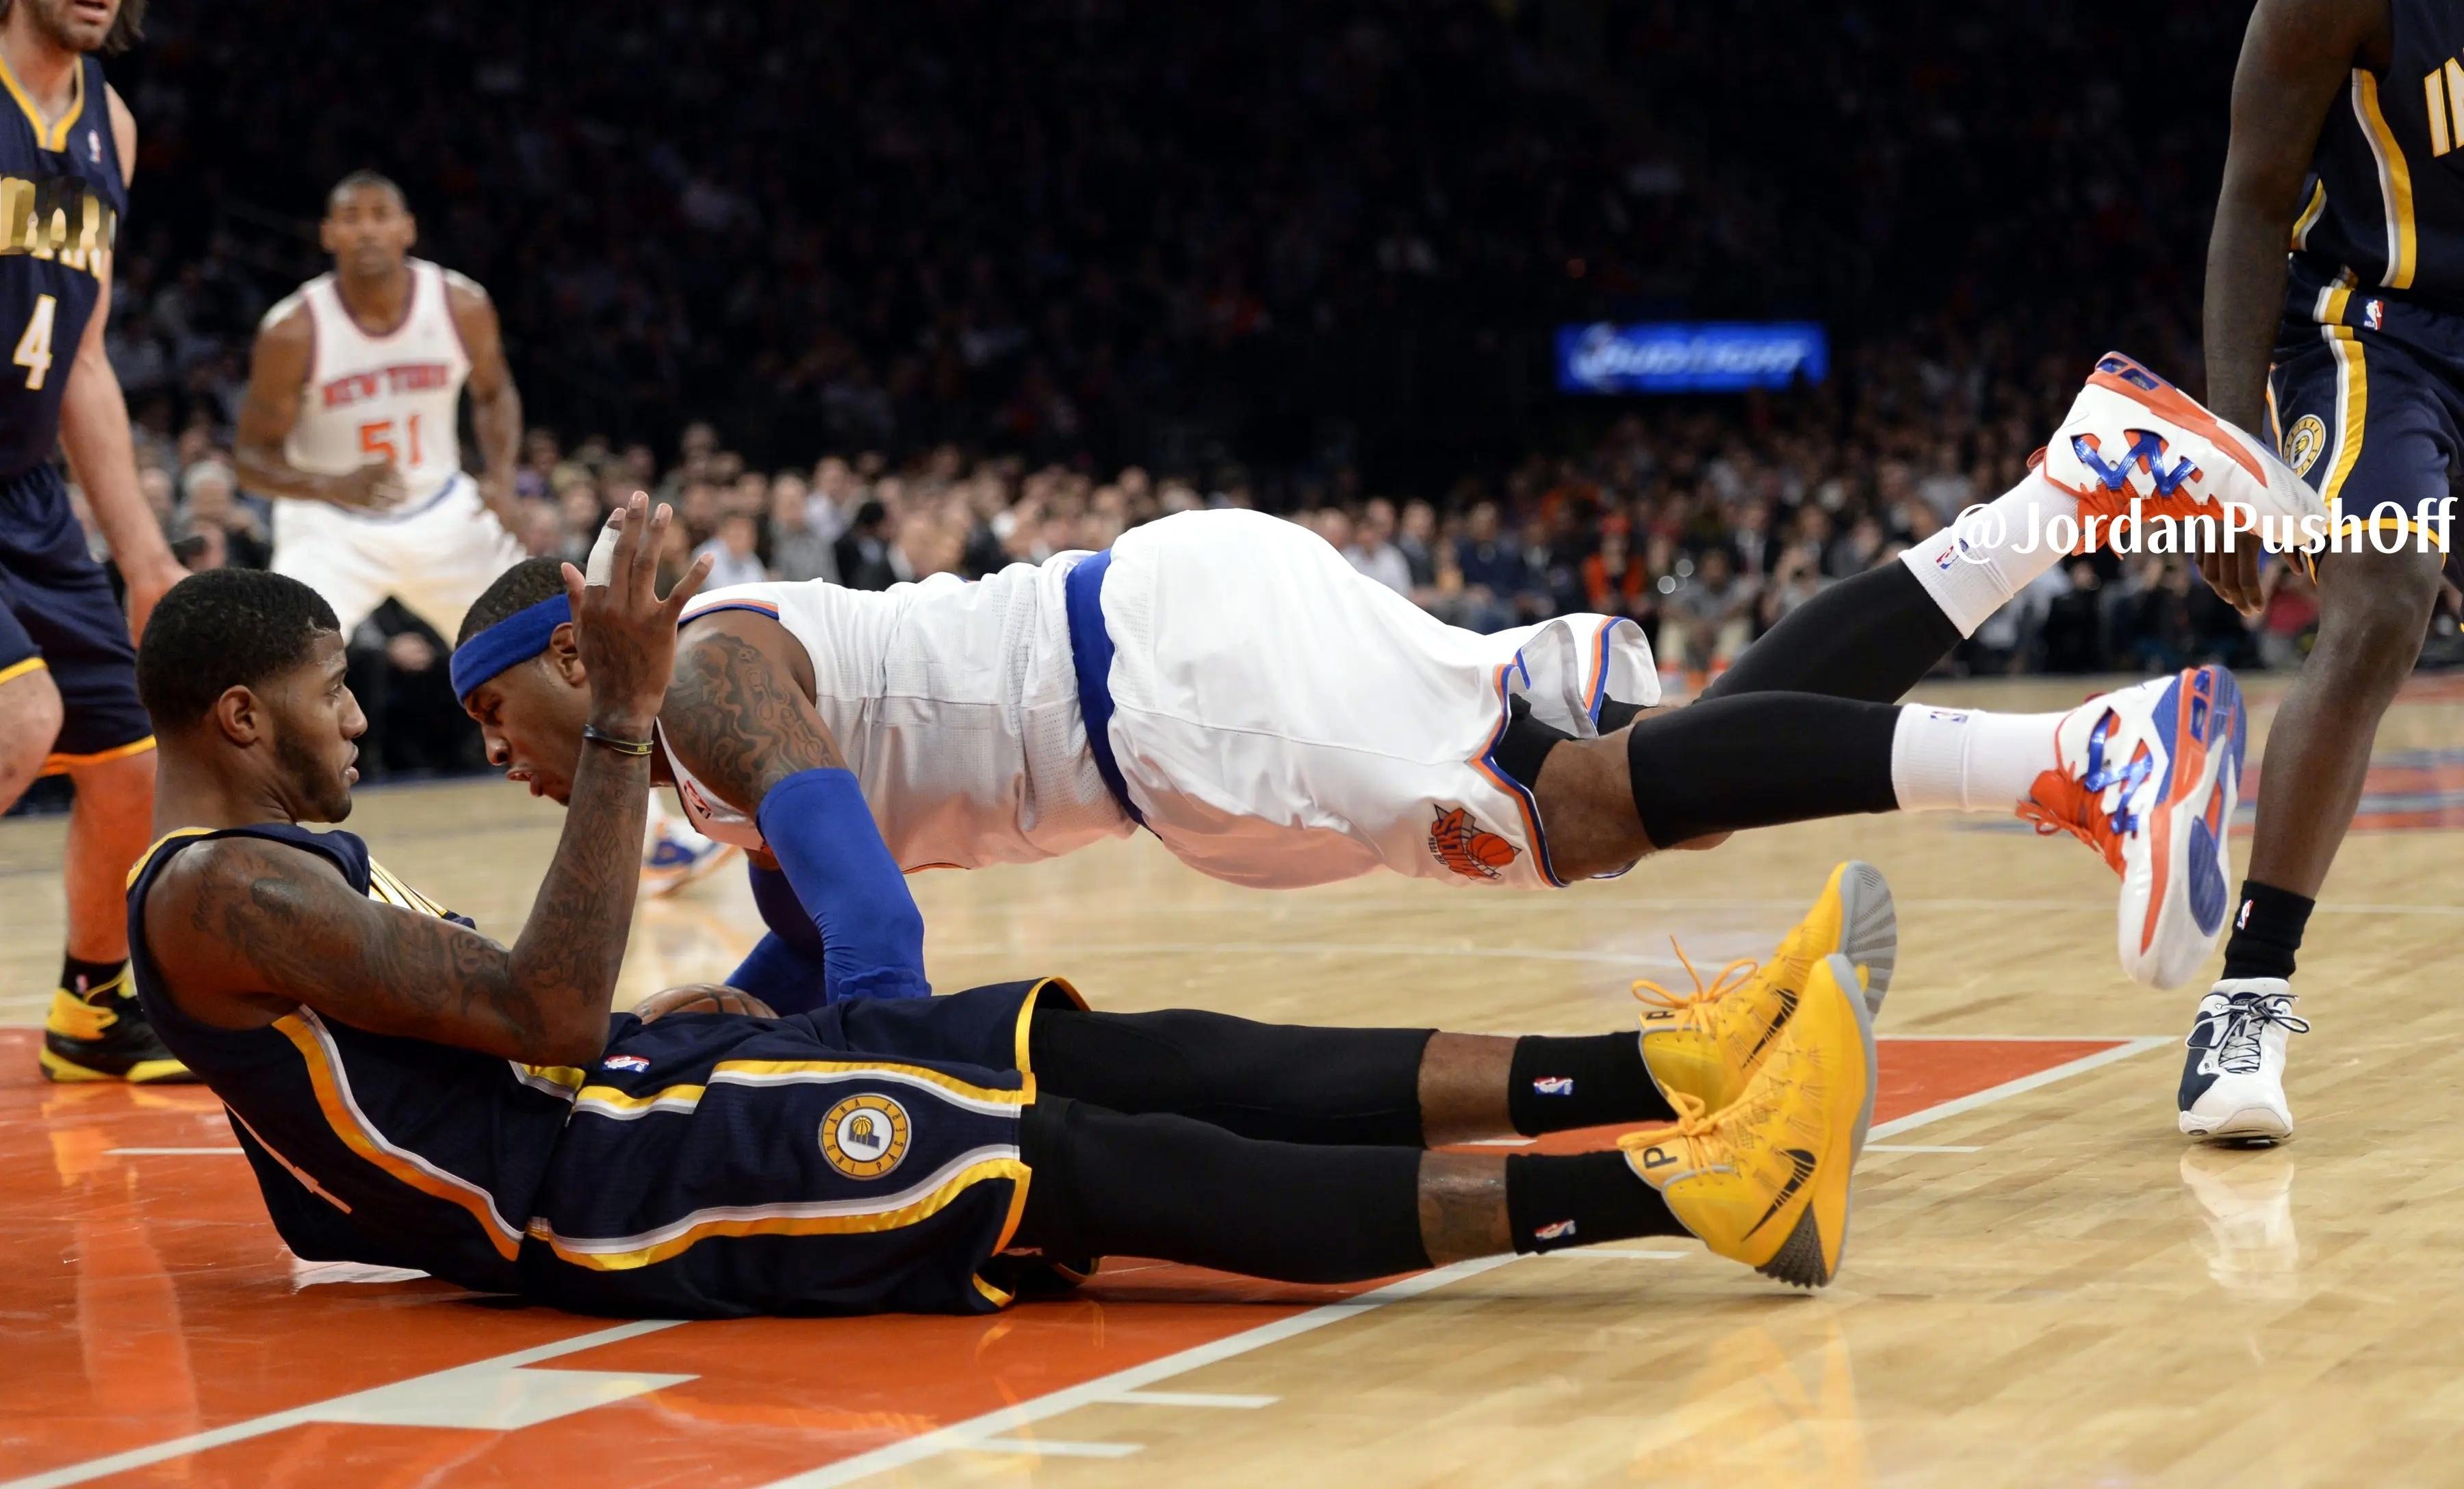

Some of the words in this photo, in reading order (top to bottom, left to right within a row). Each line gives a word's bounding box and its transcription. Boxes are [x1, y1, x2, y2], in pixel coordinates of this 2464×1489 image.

[12, 293, 57, 390] 4
[359, 414, 422, 468] 51
[1643, 1147, 1678, 1169] P
